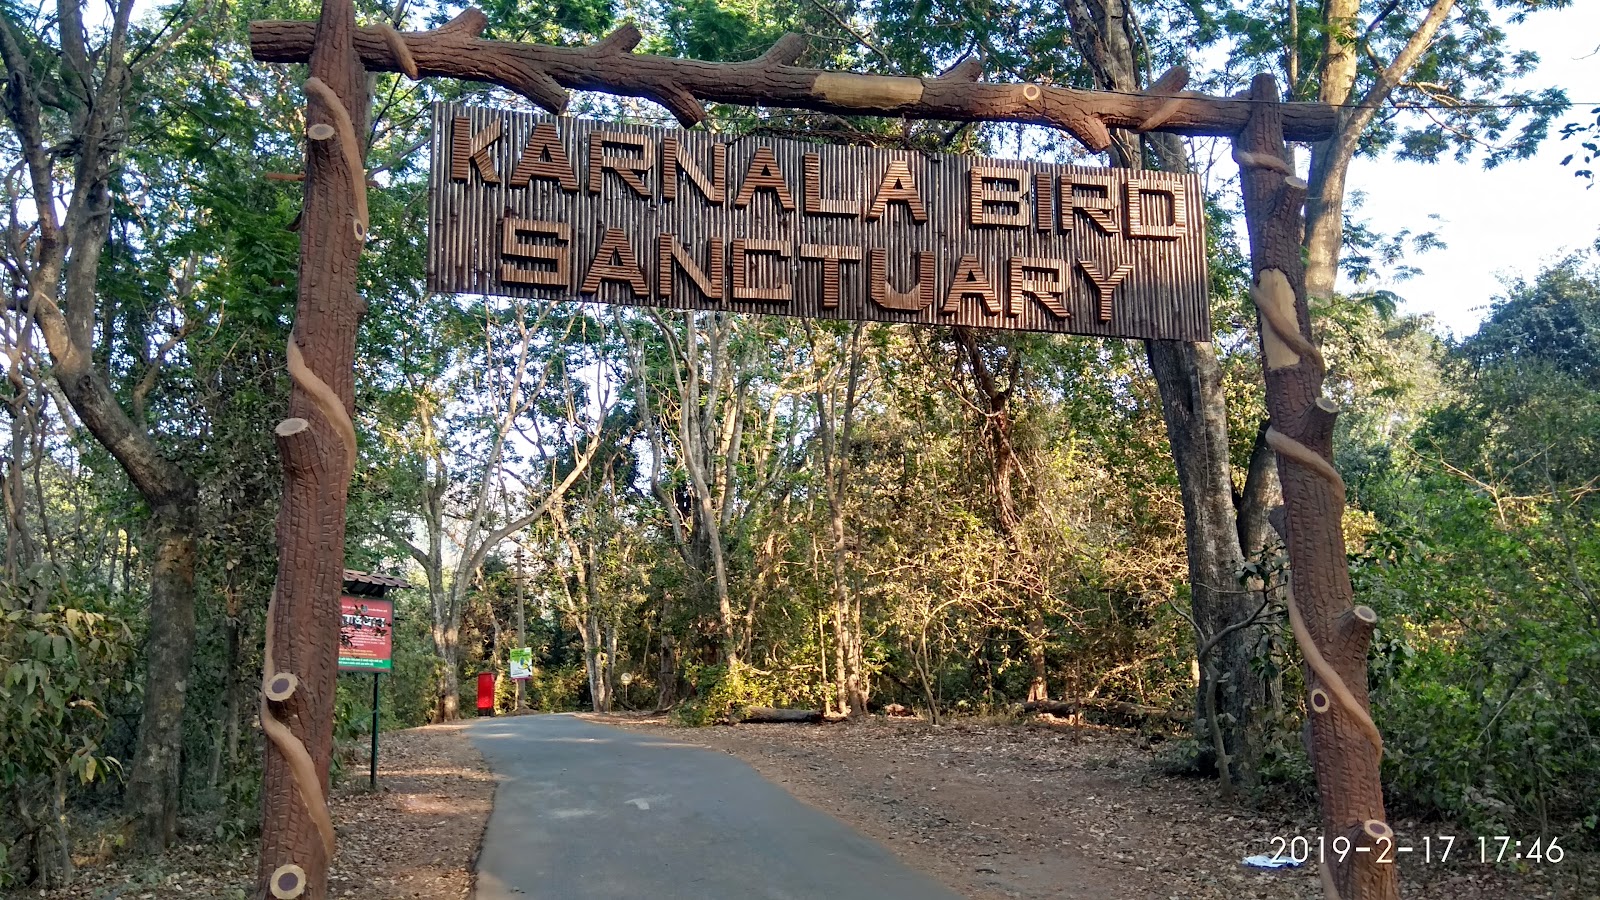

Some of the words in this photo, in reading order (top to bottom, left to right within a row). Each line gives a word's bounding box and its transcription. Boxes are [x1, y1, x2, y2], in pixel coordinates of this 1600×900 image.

[452, 115, 927, 224] KARNALA
[969, 165, 1186, 239] BIRD
[500, 217, 1135, 323] SANCTUARY
